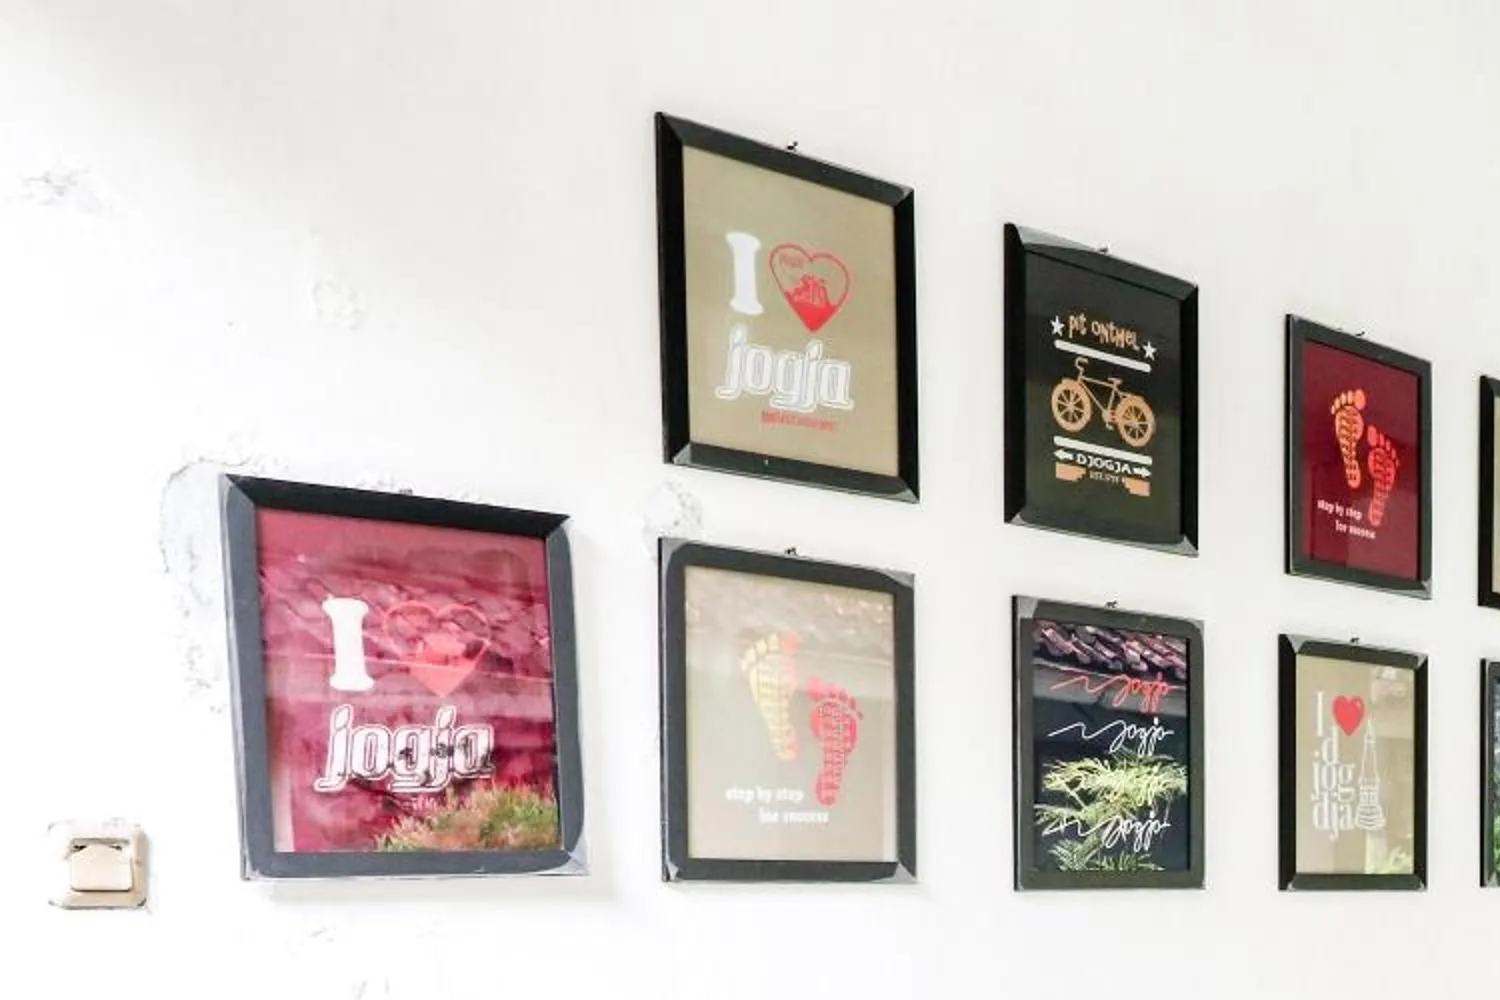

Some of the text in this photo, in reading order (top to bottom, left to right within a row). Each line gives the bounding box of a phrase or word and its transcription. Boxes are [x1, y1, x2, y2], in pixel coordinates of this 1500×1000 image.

[725, 231, 764, 315] I
[714, 324, 854, 413] jogja
[1076, 453, 1132, 475] DJOGJA
[321, 594, 375, 691] I
[314, 703, 495, 793] jogja
